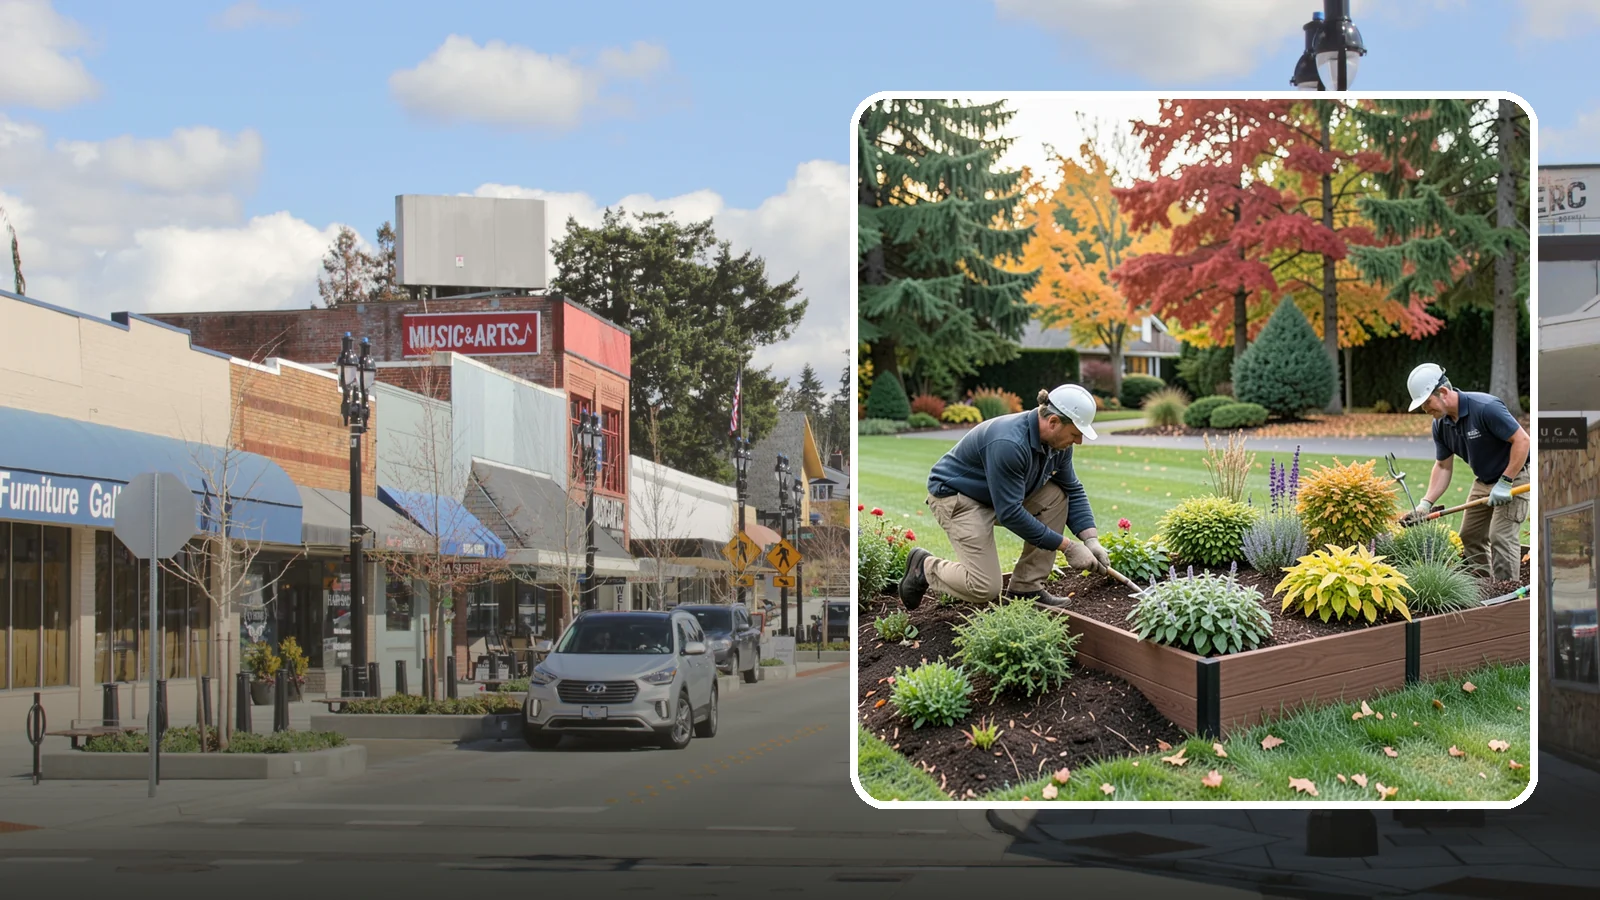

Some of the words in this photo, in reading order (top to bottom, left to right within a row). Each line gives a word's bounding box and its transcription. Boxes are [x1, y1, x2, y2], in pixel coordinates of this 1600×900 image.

[408, 322, 520, 349] MUSIC&ARTS
[0, 471, 79, 516] Furniture
[89, 482, 122, 519] Gal
[453, 563, 479, 574] SUSHI
